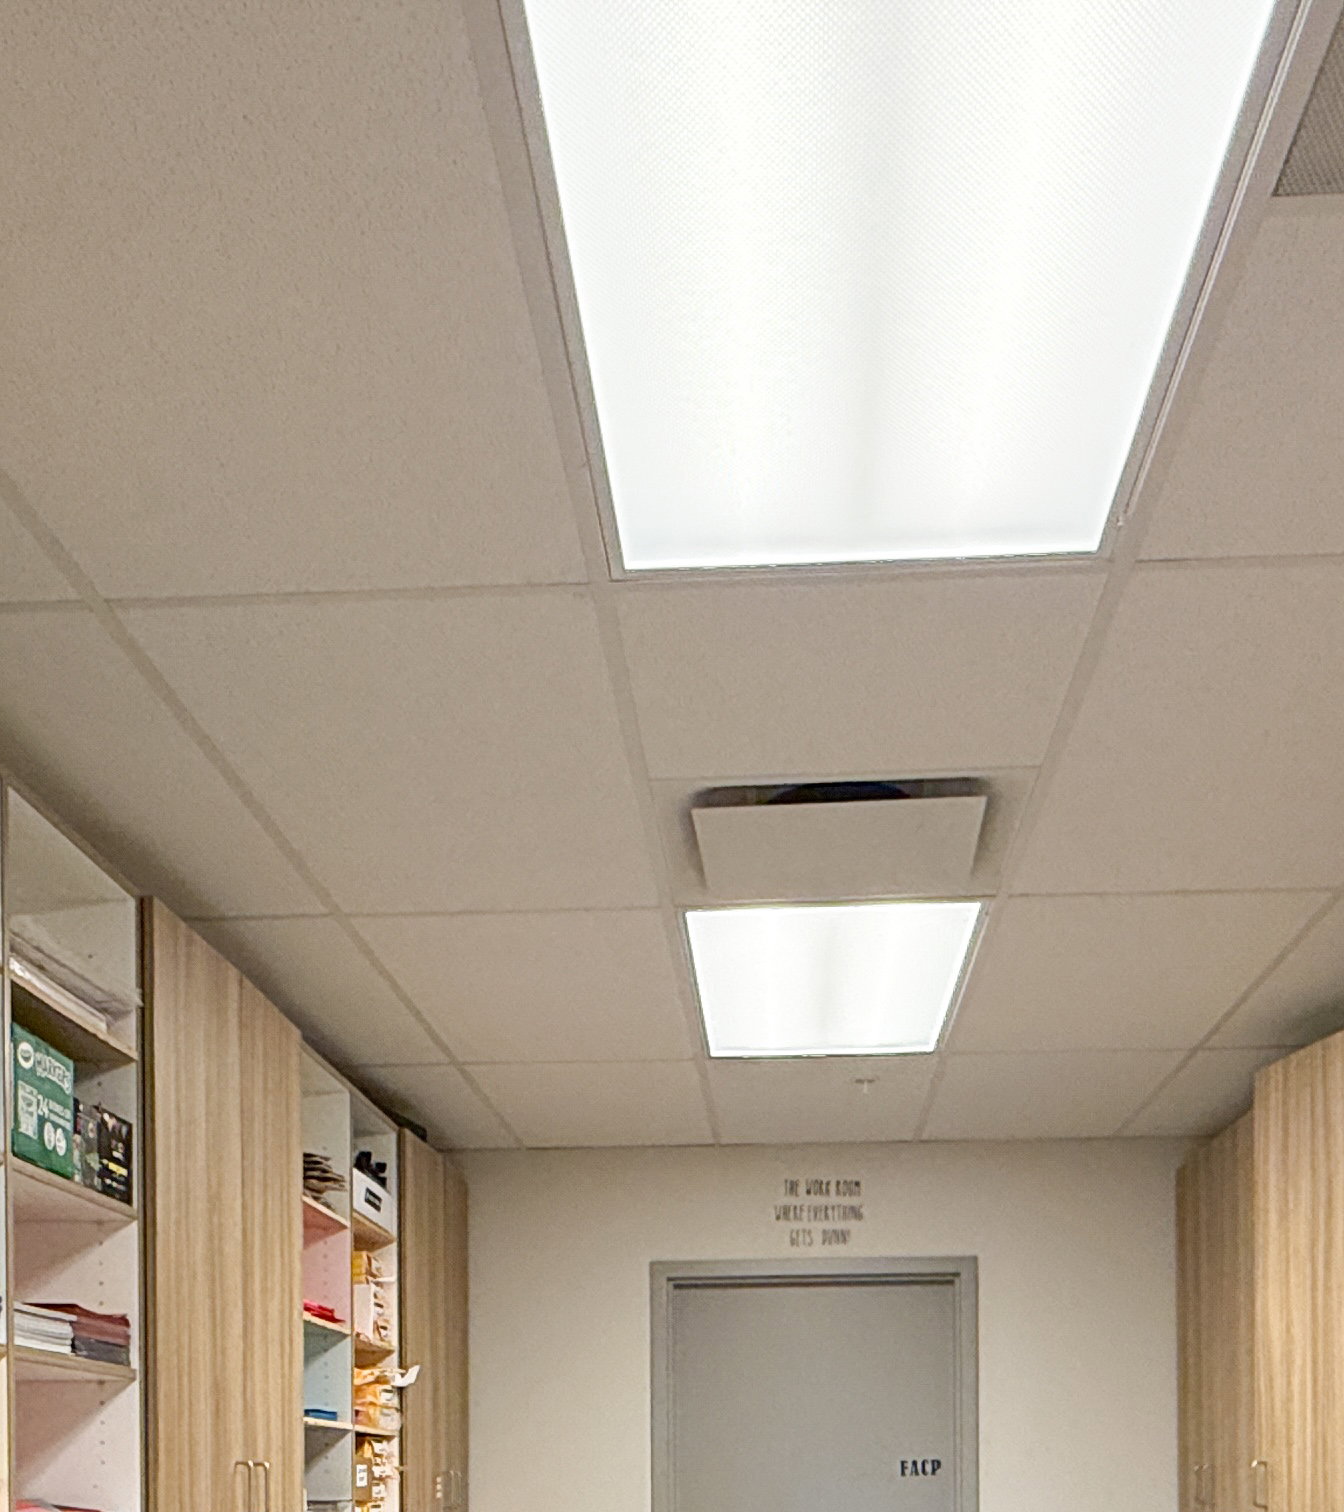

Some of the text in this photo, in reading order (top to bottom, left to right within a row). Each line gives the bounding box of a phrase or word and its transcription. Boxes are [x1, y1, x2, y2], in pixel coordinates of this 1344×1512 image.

[37, 1095, 49, 1118] 24
[784, 1179, 861, 1197] THE WORK ROOM
[774, 1203, 863, 1222] WHERE EVERYTHING
[789, 1228, 813, 1247] GETS
[900, 1459, 942, 1477] FACP
